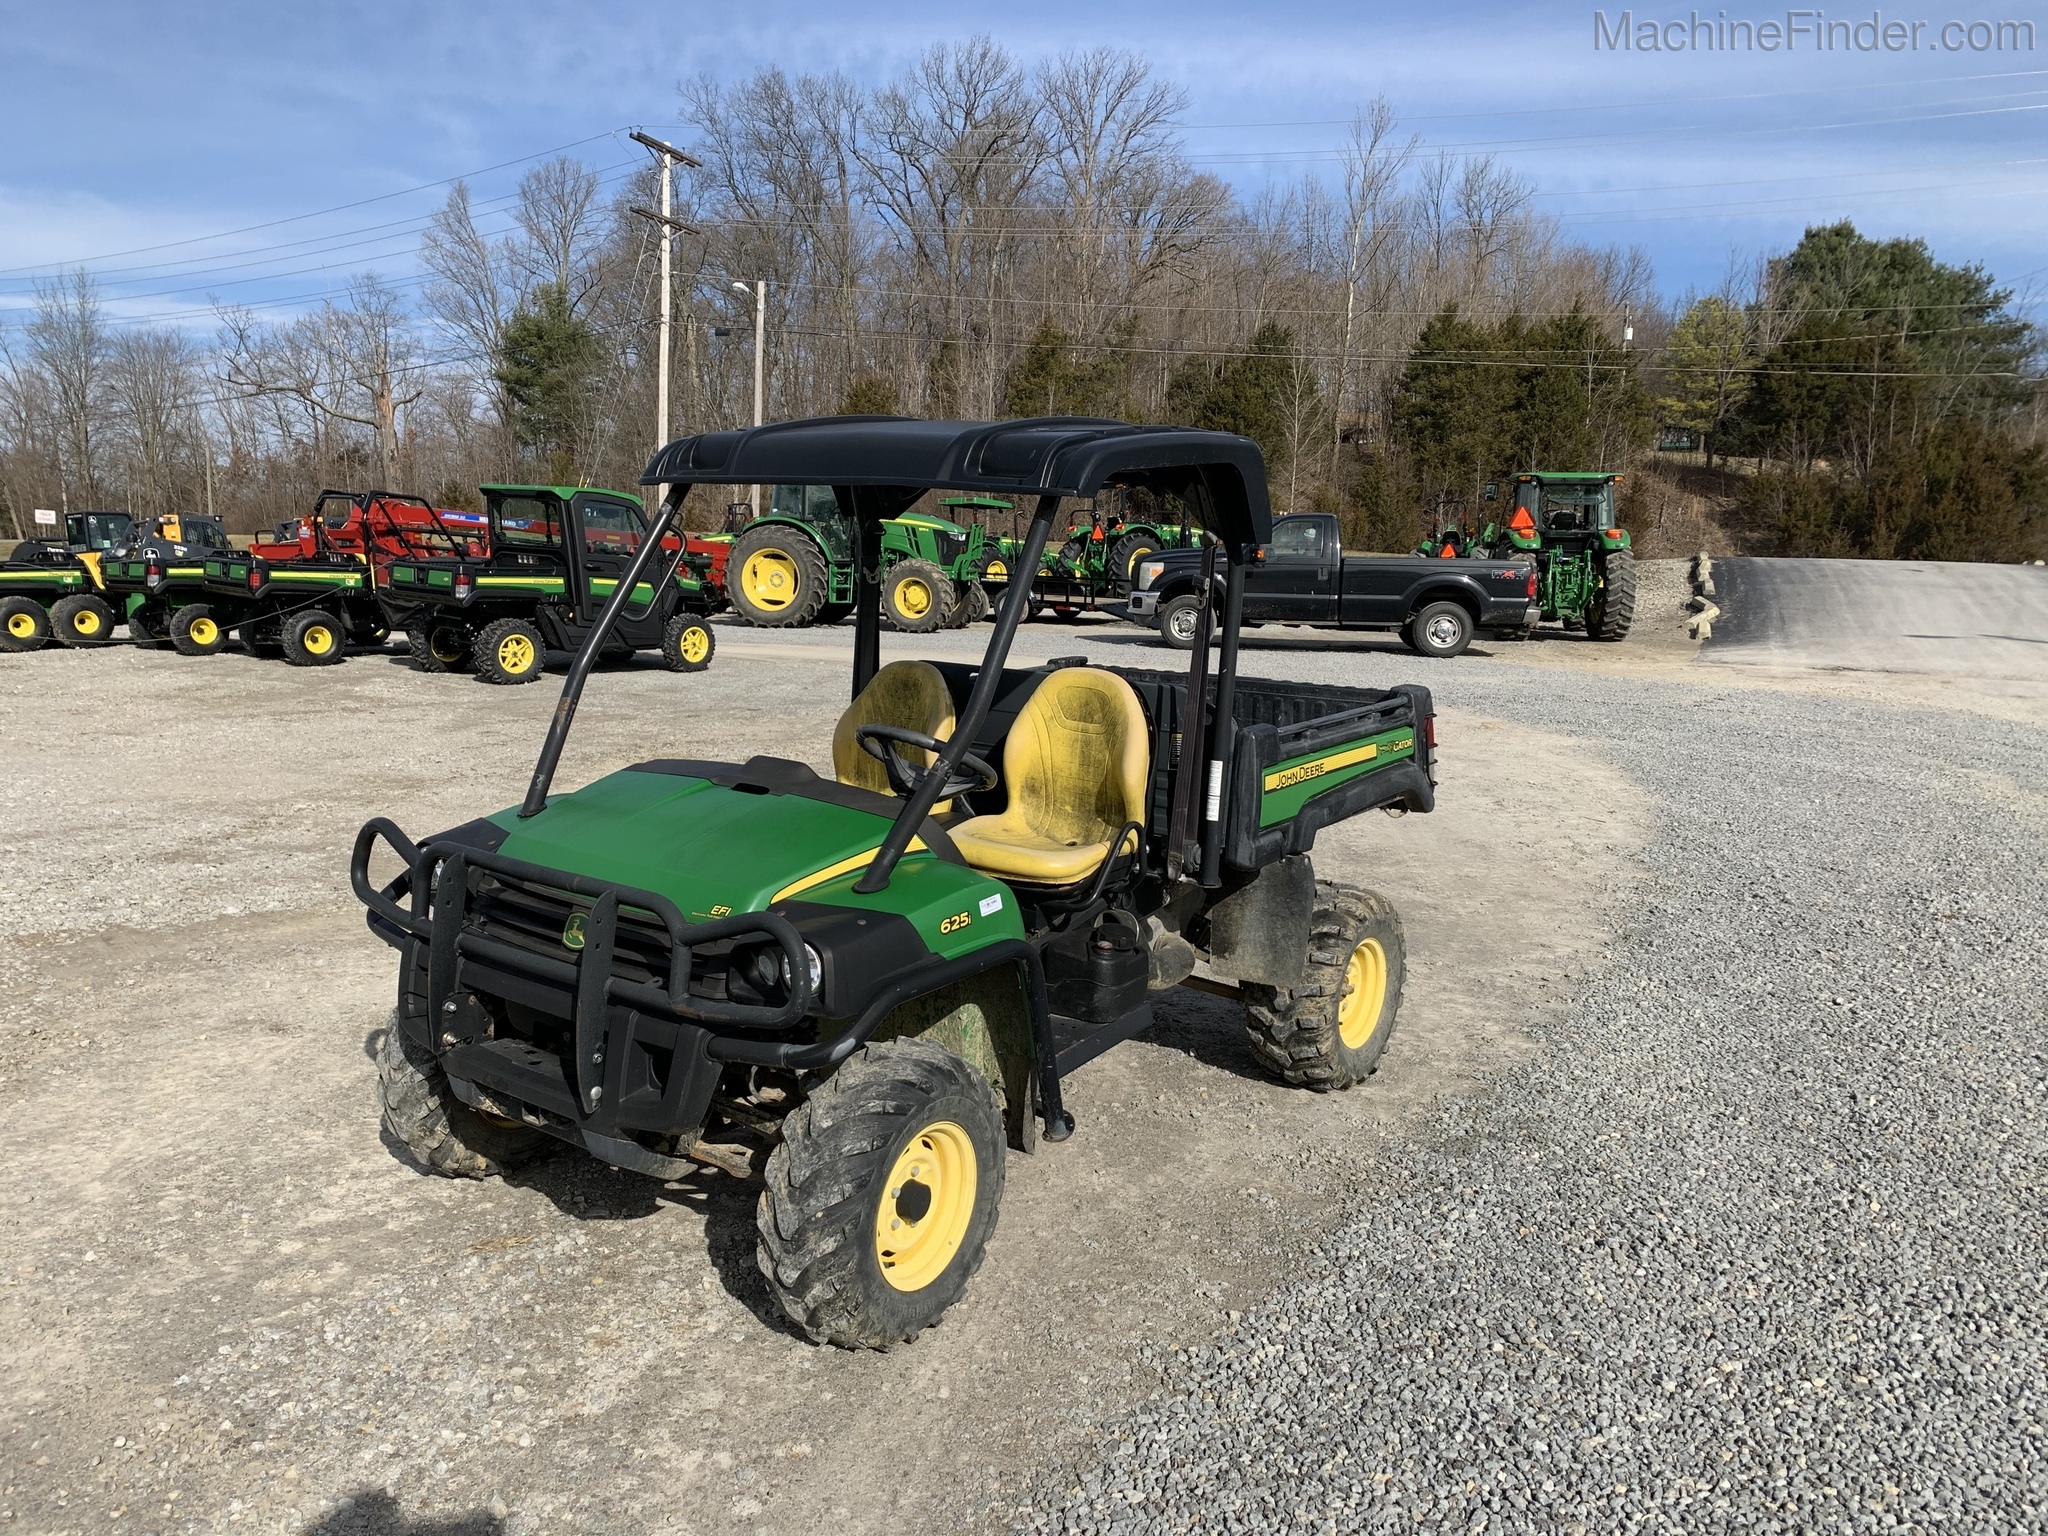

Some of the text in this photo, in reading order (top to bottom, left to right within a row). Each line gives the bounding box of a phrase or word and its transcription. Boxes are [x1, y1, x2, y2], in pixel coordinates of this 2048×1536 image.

[1393, 738, 1413, 751] GATOR
[1276, 763, 1326, 789] JOHN DEERE
[710, 904, 733, 917] EFI
[940, 911, 972, 934] 625i
